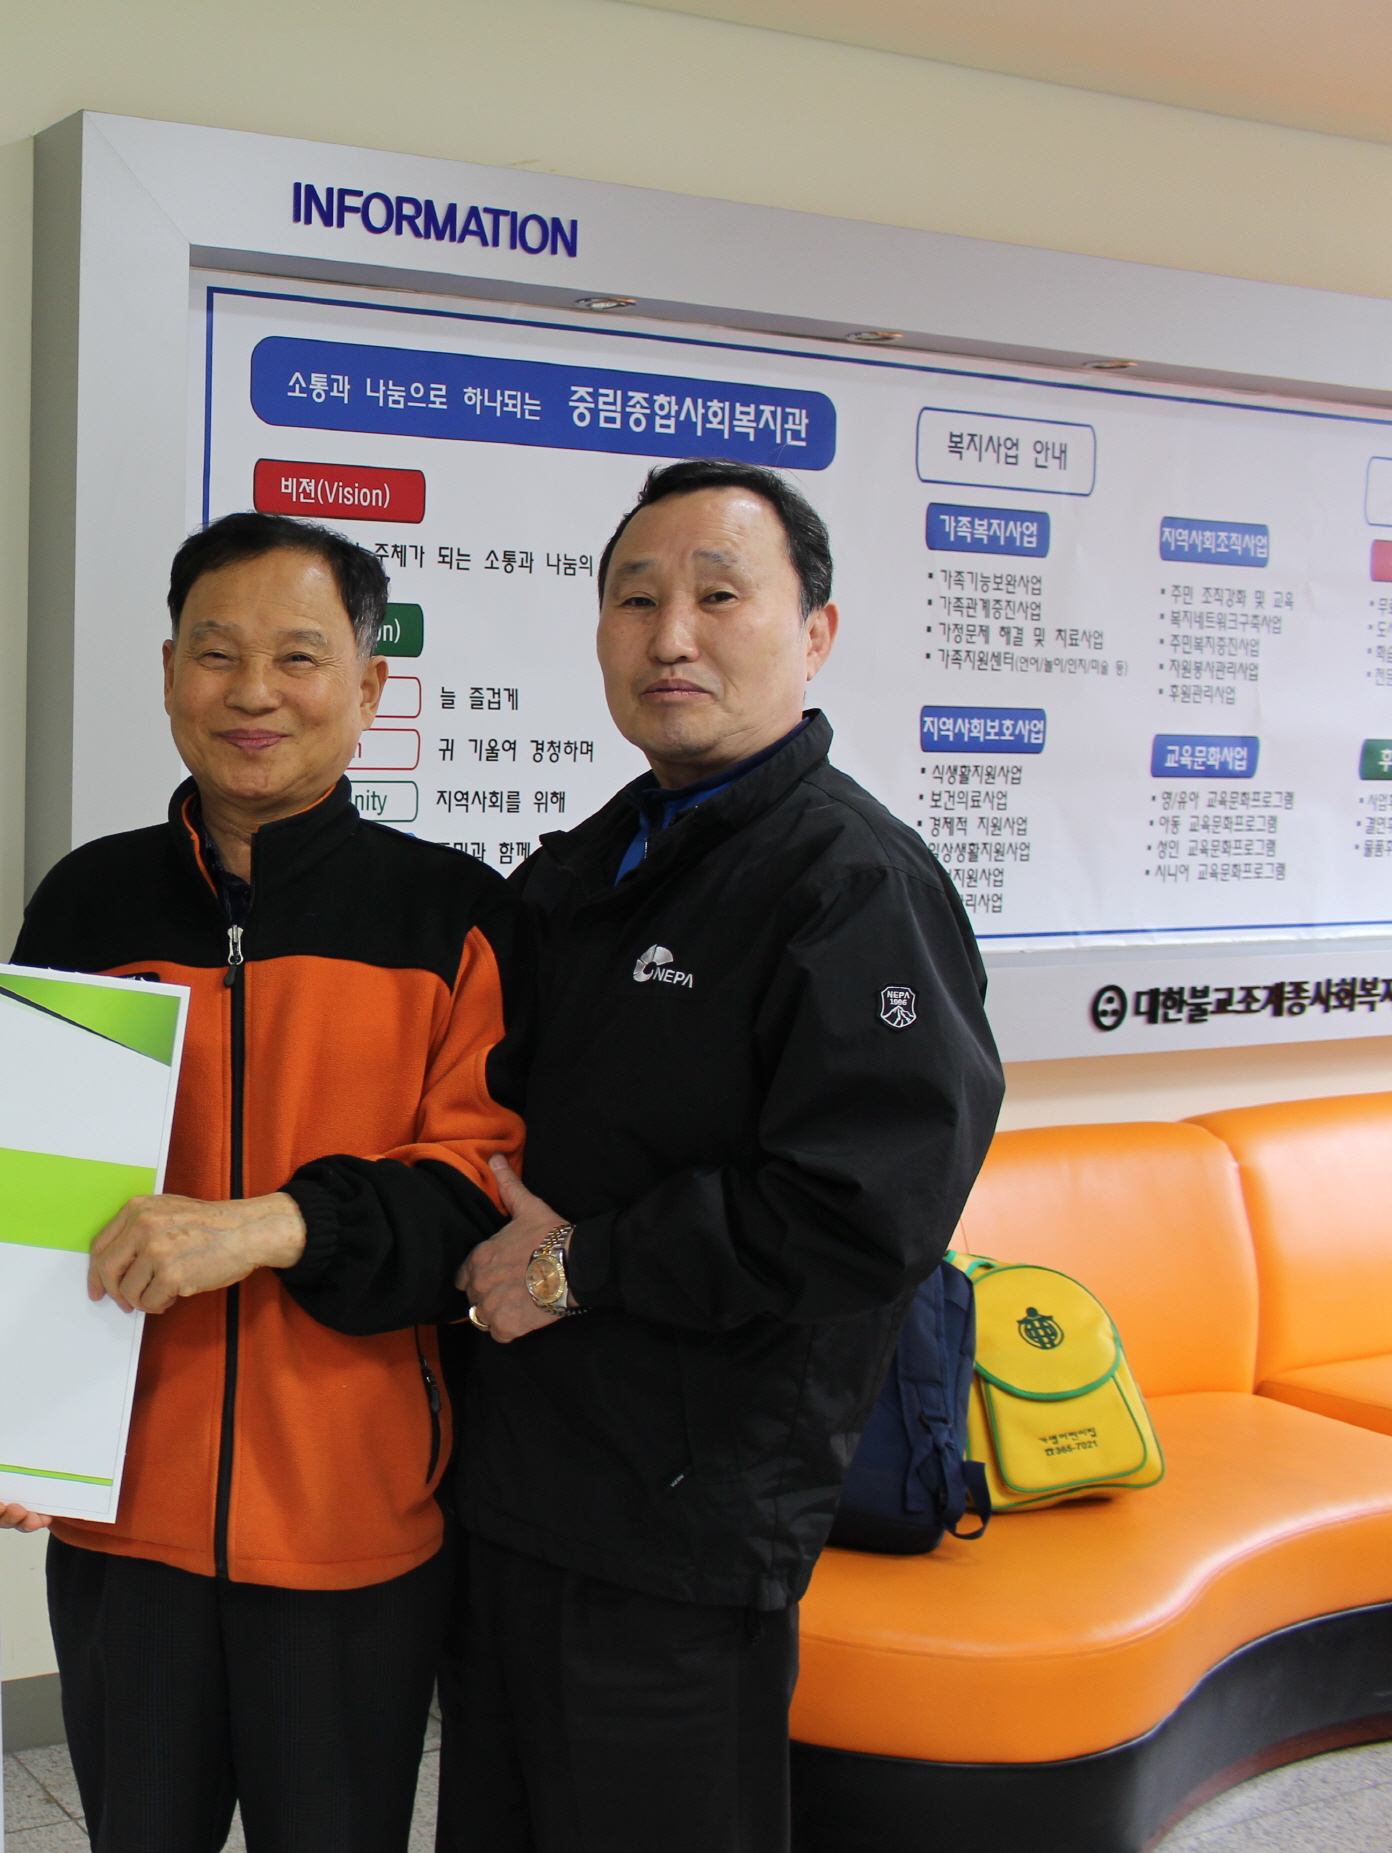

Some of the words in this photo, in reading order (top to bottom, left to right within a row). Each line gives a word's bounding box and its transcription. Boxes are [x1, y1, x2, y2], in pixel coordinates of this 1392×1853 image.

[291, 181, 578, 257] INFORMATION
[287, 371, 351, 406] 소통과
[365, 377, 448, 410] 나눔으로
[463, 385, 541, 421] 하나되는
[568, 384, 809, 447] 중림종합사회복지관
[947, 431, 1020, 466] 복지사업
[1032, 439, 1068, 471] 안내
[939, 515, 1038, 548] 가족복지사업
[1161, 526, 1269, 558] 지역사회조직사업
[374, 542, 425, 568] 주체가
[438, 546, 472, 571] 되는
[484, 549, 534, 574] 소통과
[546, 553, 593, 577] 나눔의
[940, 569, 1042, 596] 가족기능보완사업
[939, 596, 1041, 621] 가족관계증진사업
[1171, 585, 1193, 605] 주민
[1202, 586, 1246, 608] 조직강화
[1255, 590, 1265, 609] 및
[1273, 591, 1294, 611] 교육
[1170, 610, 1282, 635] 복지네트워크구축사업
[938, 622, 990, 645] 가정문제
[999, 625, 1023, 647] 해결
[1033, 627, 1045, 648] 및
[1055, 628, 1104, 650] 치료사업
[1170, 634, 1260, 658] 주민복지증진사업
[1169, 659, 1258, 681] 자원봉사관리사업
[440, 687, 456, 711] 늘
[469, 686, 519, 711] 즐겁게
[1169, 684, 1236, 705] 후원관리사업
[922, 715, 1044, 745] 지역사회보호사업
[438, 739, 455, 762] 귀
[469, 738, 517, 762] 기울여
[530, 739, 594, 763] 경청하며
[1164, 745, 1248, 774] 교육문화사업
[932, 765, 1022, 785] 식생활지원사업
[436, 789, 521, 814] 지역사회를
[533, 789, 566, 814] 위해
[930, 790, 1008, 811] 보건의료사업
[1206, 790, 1294, 810] 교육문화프로그램
[929, 816, 968, 837] 경제적
[978, 816, 1028, 836] 지원사업
[1159, 815, 1181, 835] 아동
[1189, 815, 1277, 834] 교육문화프로그램
[499, 842, 530, 865] 함께
[1157, 839, 1179, 860] 성인
[1188, 839, 1276, 858] 교육문화프로그램
[948, 868, 1004, 888] 지원사업
[1155, 864, 1189, 883] 시니어
[1197, 862, 1286, 882] 교육문화프로그램
[960, 893, 1003, 914] 리사업
[653, 967, 694, 988] NEPA
[886, 990, 910, 999] NEPA
